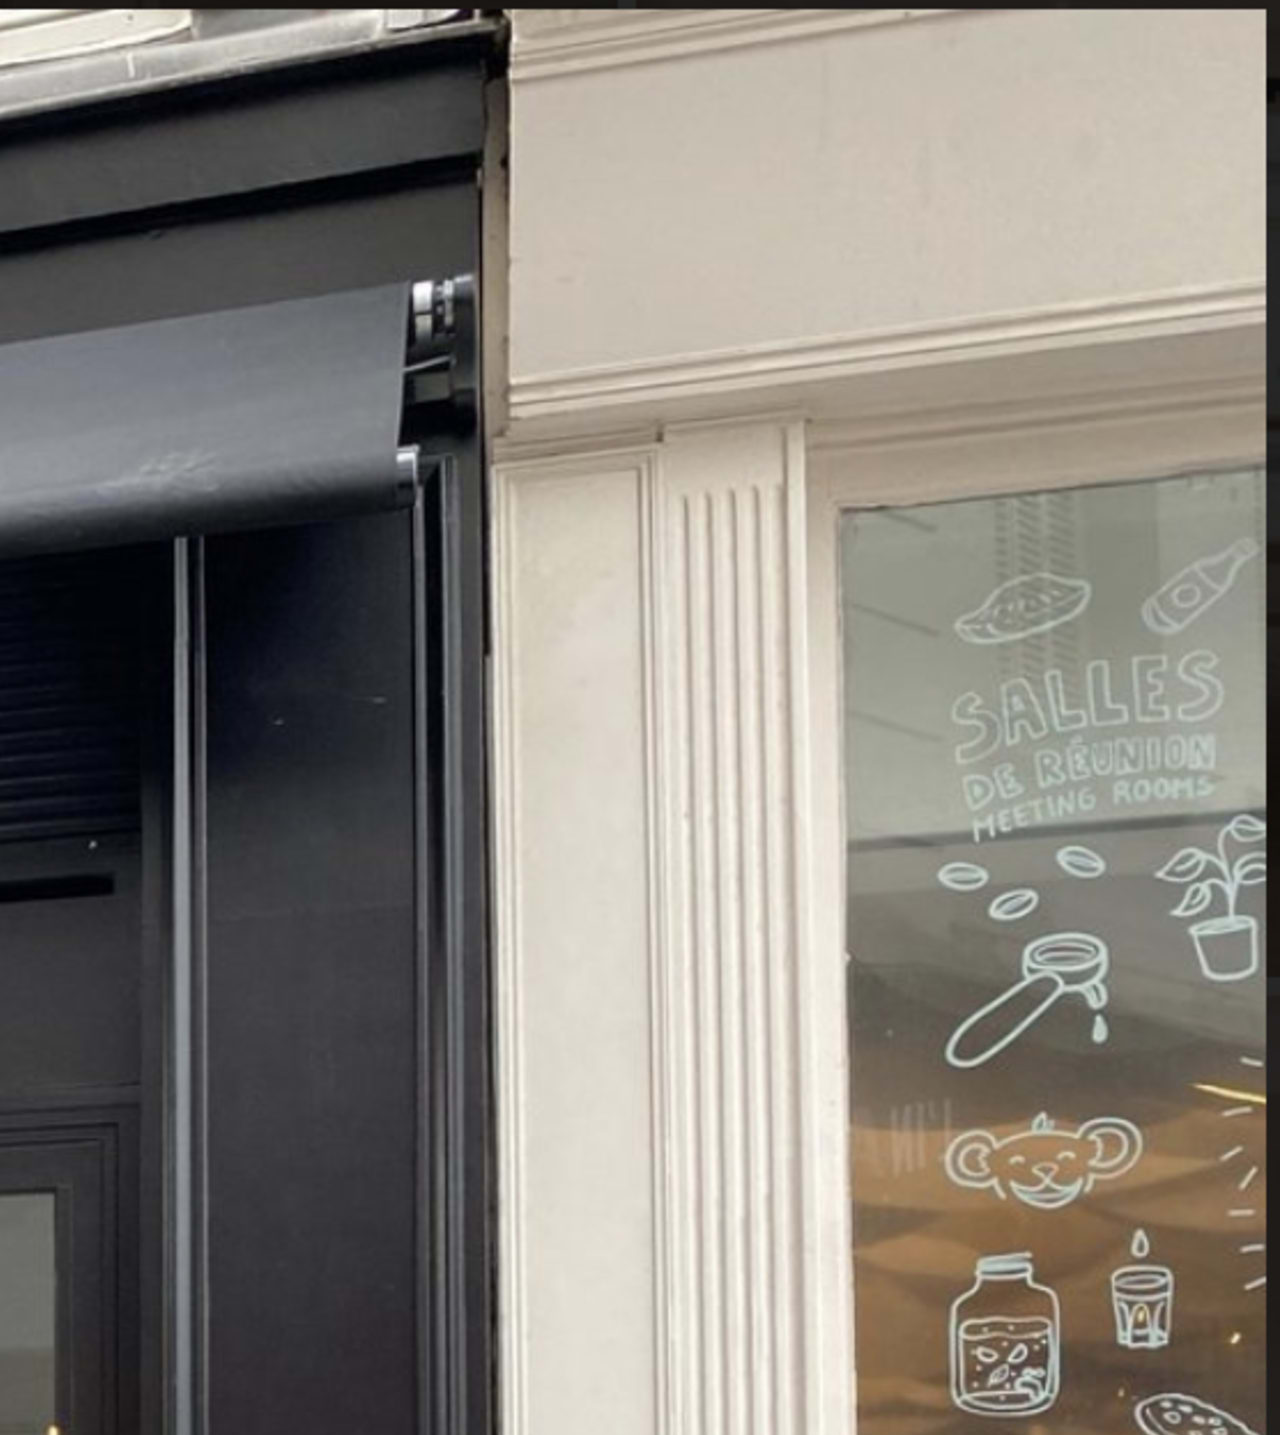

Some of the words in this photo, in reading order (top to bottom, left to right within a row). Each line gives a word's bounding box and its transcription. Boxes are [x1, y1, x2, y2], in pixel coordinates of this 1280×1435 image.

[952, 650, 1225, 765] SALLES
[963, 763, 1025, 811] DE
[1035, 734, 1216, 788] RÉUNION
[972, 787, 1096, 842] MEETING
[1113, 776, 1216, 805] ROOMS
